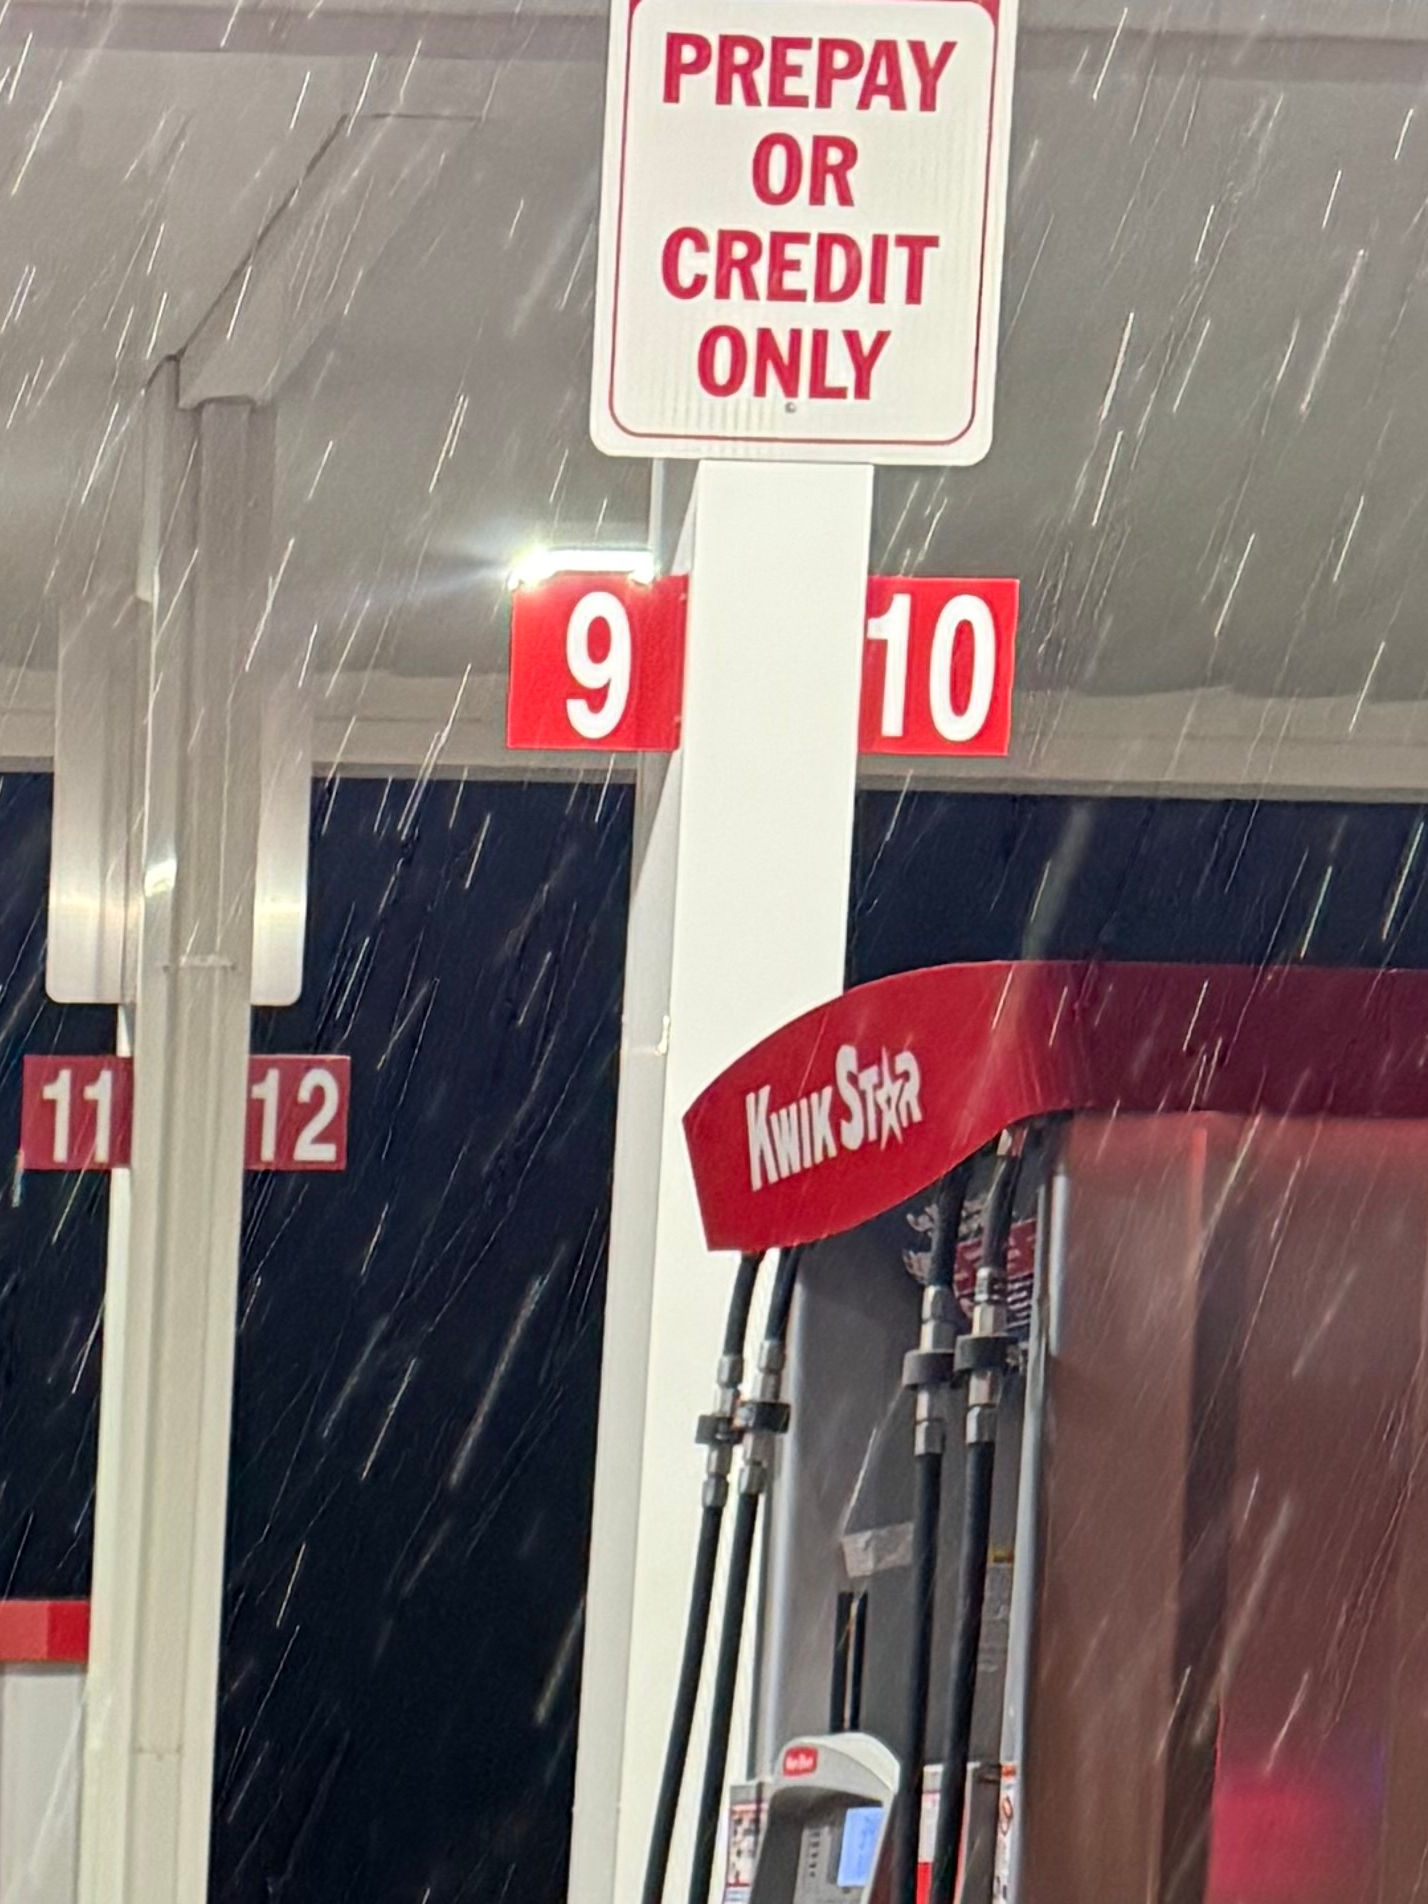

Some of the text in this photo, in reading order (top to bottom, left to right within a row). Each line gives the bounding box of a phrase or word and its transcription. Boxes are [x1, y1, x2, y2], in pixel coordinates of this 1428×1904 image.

[662, 31, 957, 113] PREPAY
[751, 131, 859, 208] OR
[660, 227, 940, 306] CREDIT
[696, 323, 892, 401] ONLY
[564, 591, 632, 740] 9
[866, 592, 997, 742] 10
[42, 1068, 114, 1162] 11
[250, 1067, 340, 1162] 12
